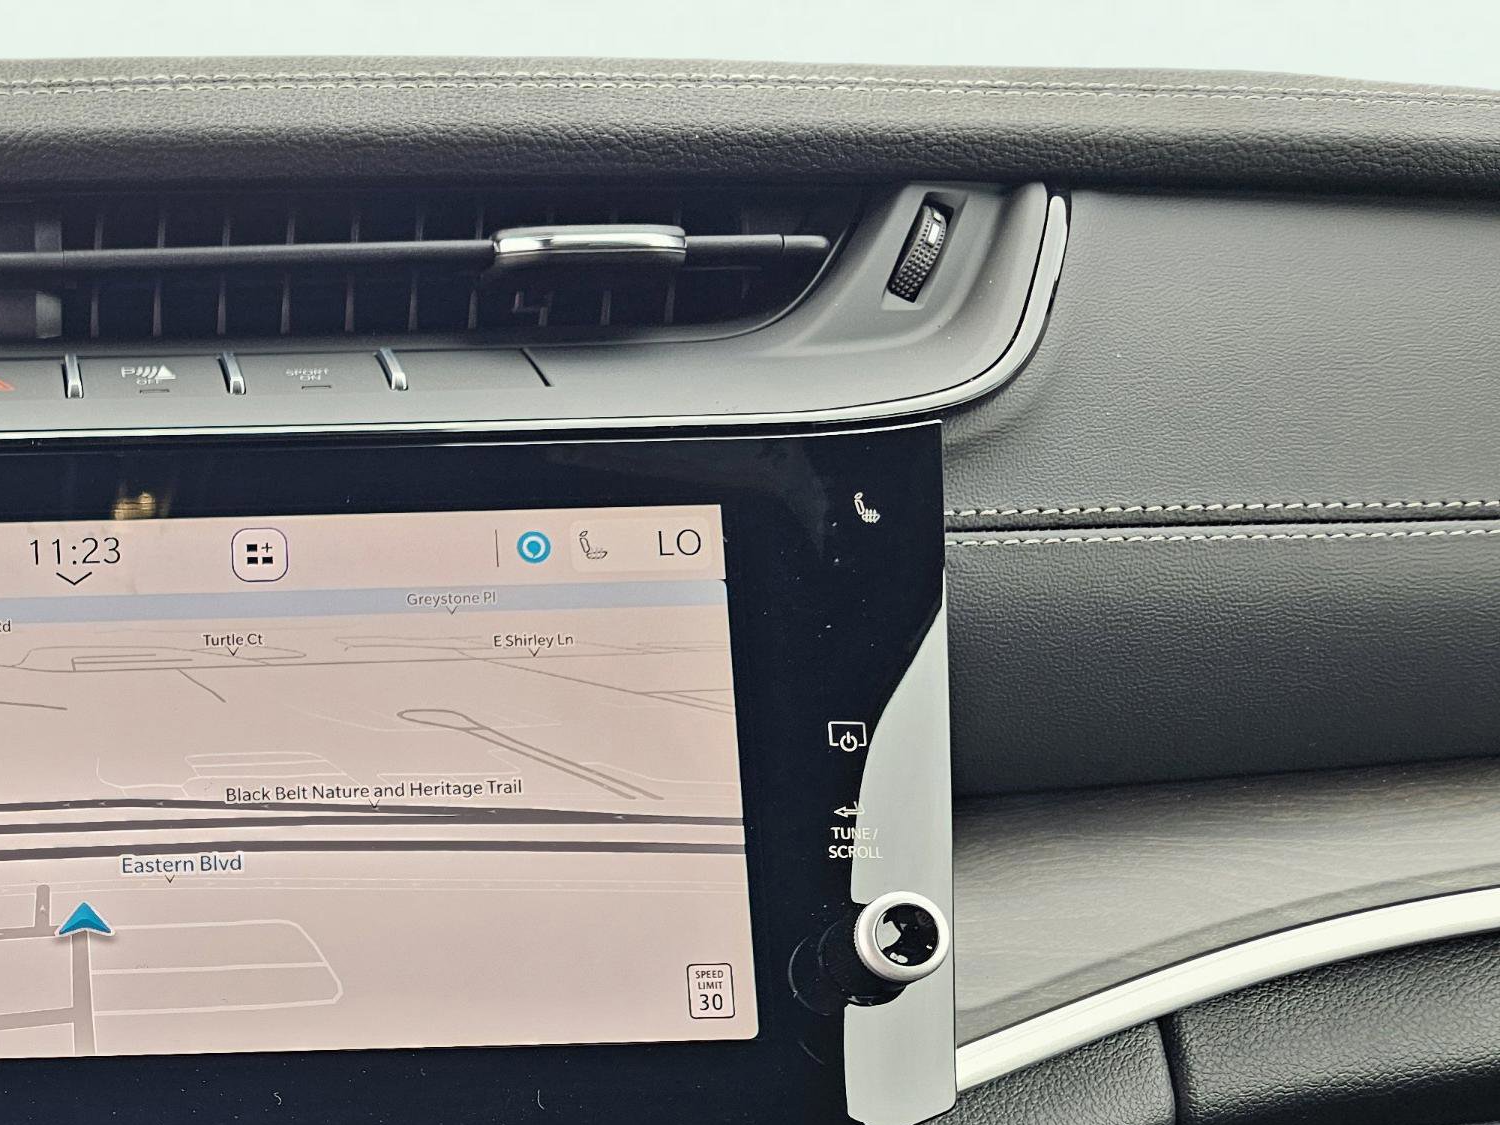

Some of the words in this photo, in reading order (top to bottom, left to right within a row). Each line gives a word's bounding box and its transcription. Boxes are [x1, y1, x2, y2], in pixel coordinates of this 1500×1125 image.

[286, 368, 329, 376] SPORT
[28, 536, 122, 566] 11:23
[657, 527, 702, 557] LO
[406, 591, 480, 608] Greystone
[483, 590, 496, 604] Pl
[203, 633, 244, 647] Turtle
[247, 633, 263, 646] Ct
[493, 634, 502, 648] E
[504, 632, 555, 650] Shirley
[558, 632, 574, 646] Ln
[226, 786, 272, 803] Black
[275, 785, 308, 801] Belt
[312, 784, 370, 800] Nature
[373, 782, 406, 798] and
[410, 780, 484, 801] Heritage
[486, 779, 522, 794] Trail
[830, 827, 878, 840] TUNE/
[828, 846, 883, 860] SCROLL
[122, 856, 194, 874] Eastern
[200, 854, 242, 872] Blvd
[695, 970, 724, 980] SPEED
[698, 980, 723, 990] LIMIT
[698, 993, 724, 1012] 30
